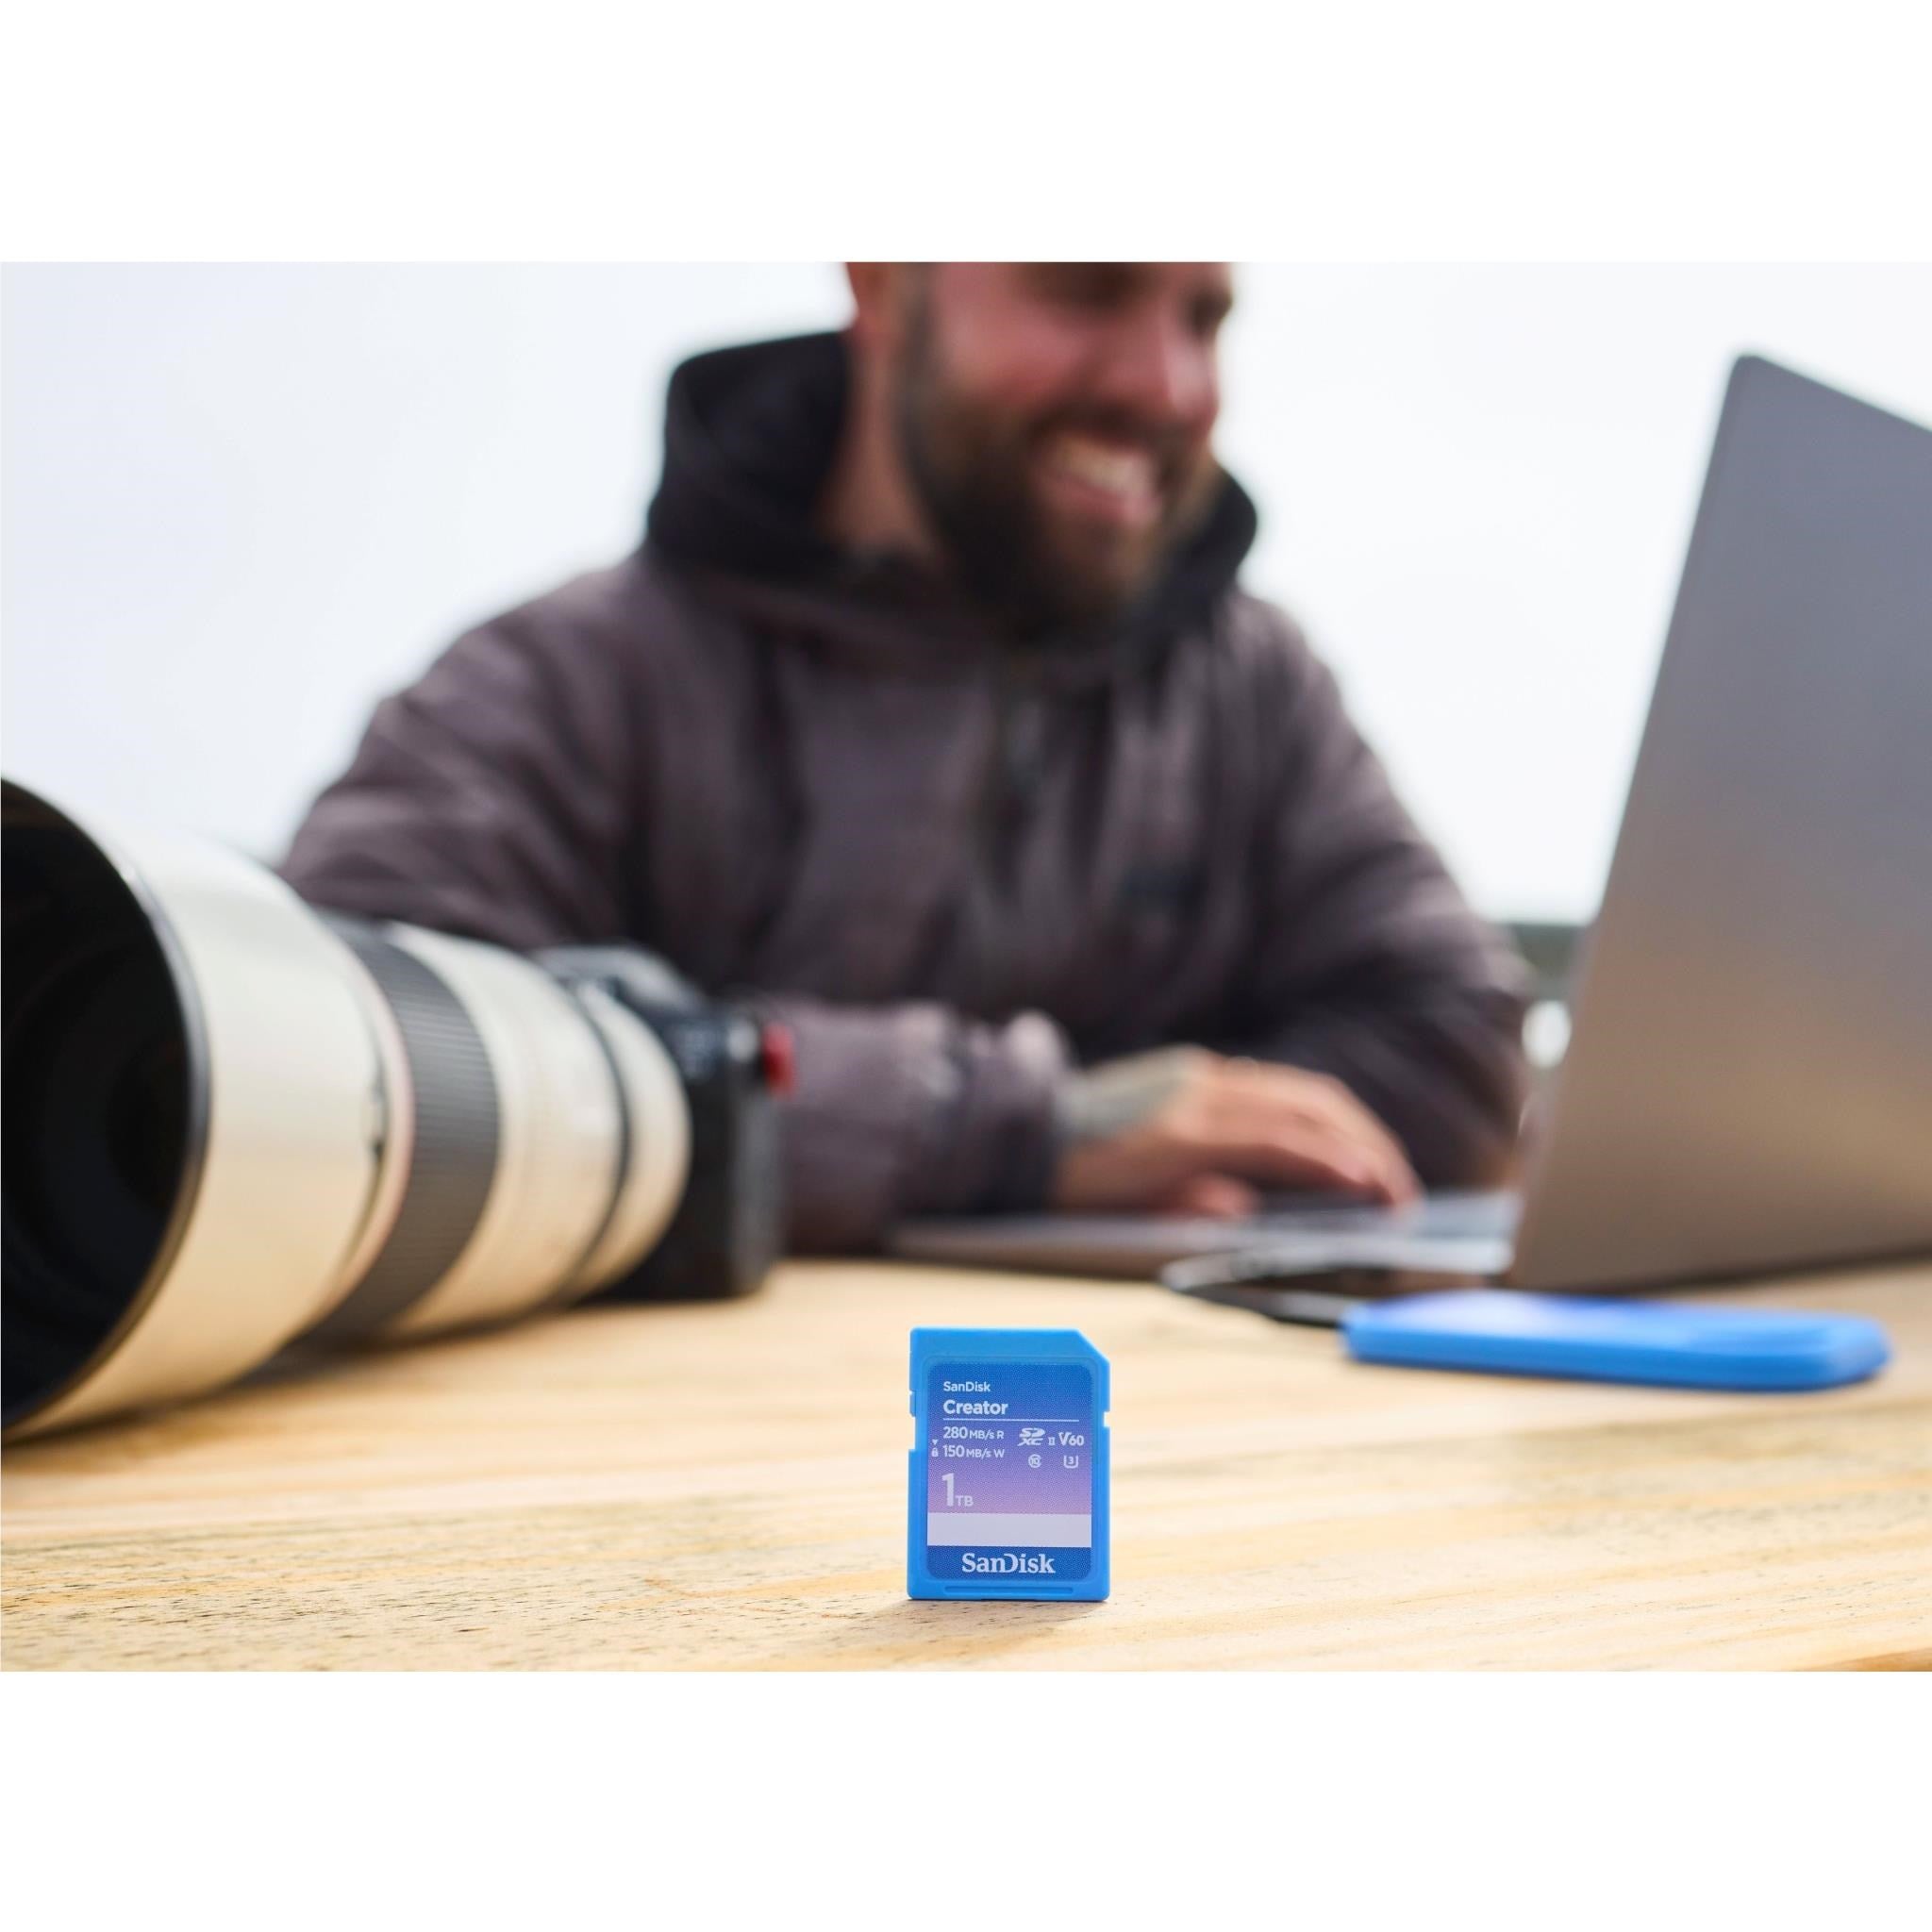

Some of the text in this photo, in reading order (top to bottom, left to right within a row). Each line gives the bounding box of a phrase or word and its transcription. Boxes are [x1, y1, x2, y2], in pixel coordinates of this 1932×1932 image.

[943, 1381, 991, 1392] SanDisk
[943, 1399, 1008, 1415] Creator
[997, 1431, 1004, 1440] R
[1058, 1432, 1084, 1446] V60
[994, 1449, 1005, 1457] W
[962, 1553, 1056, 1574] SanDisk
